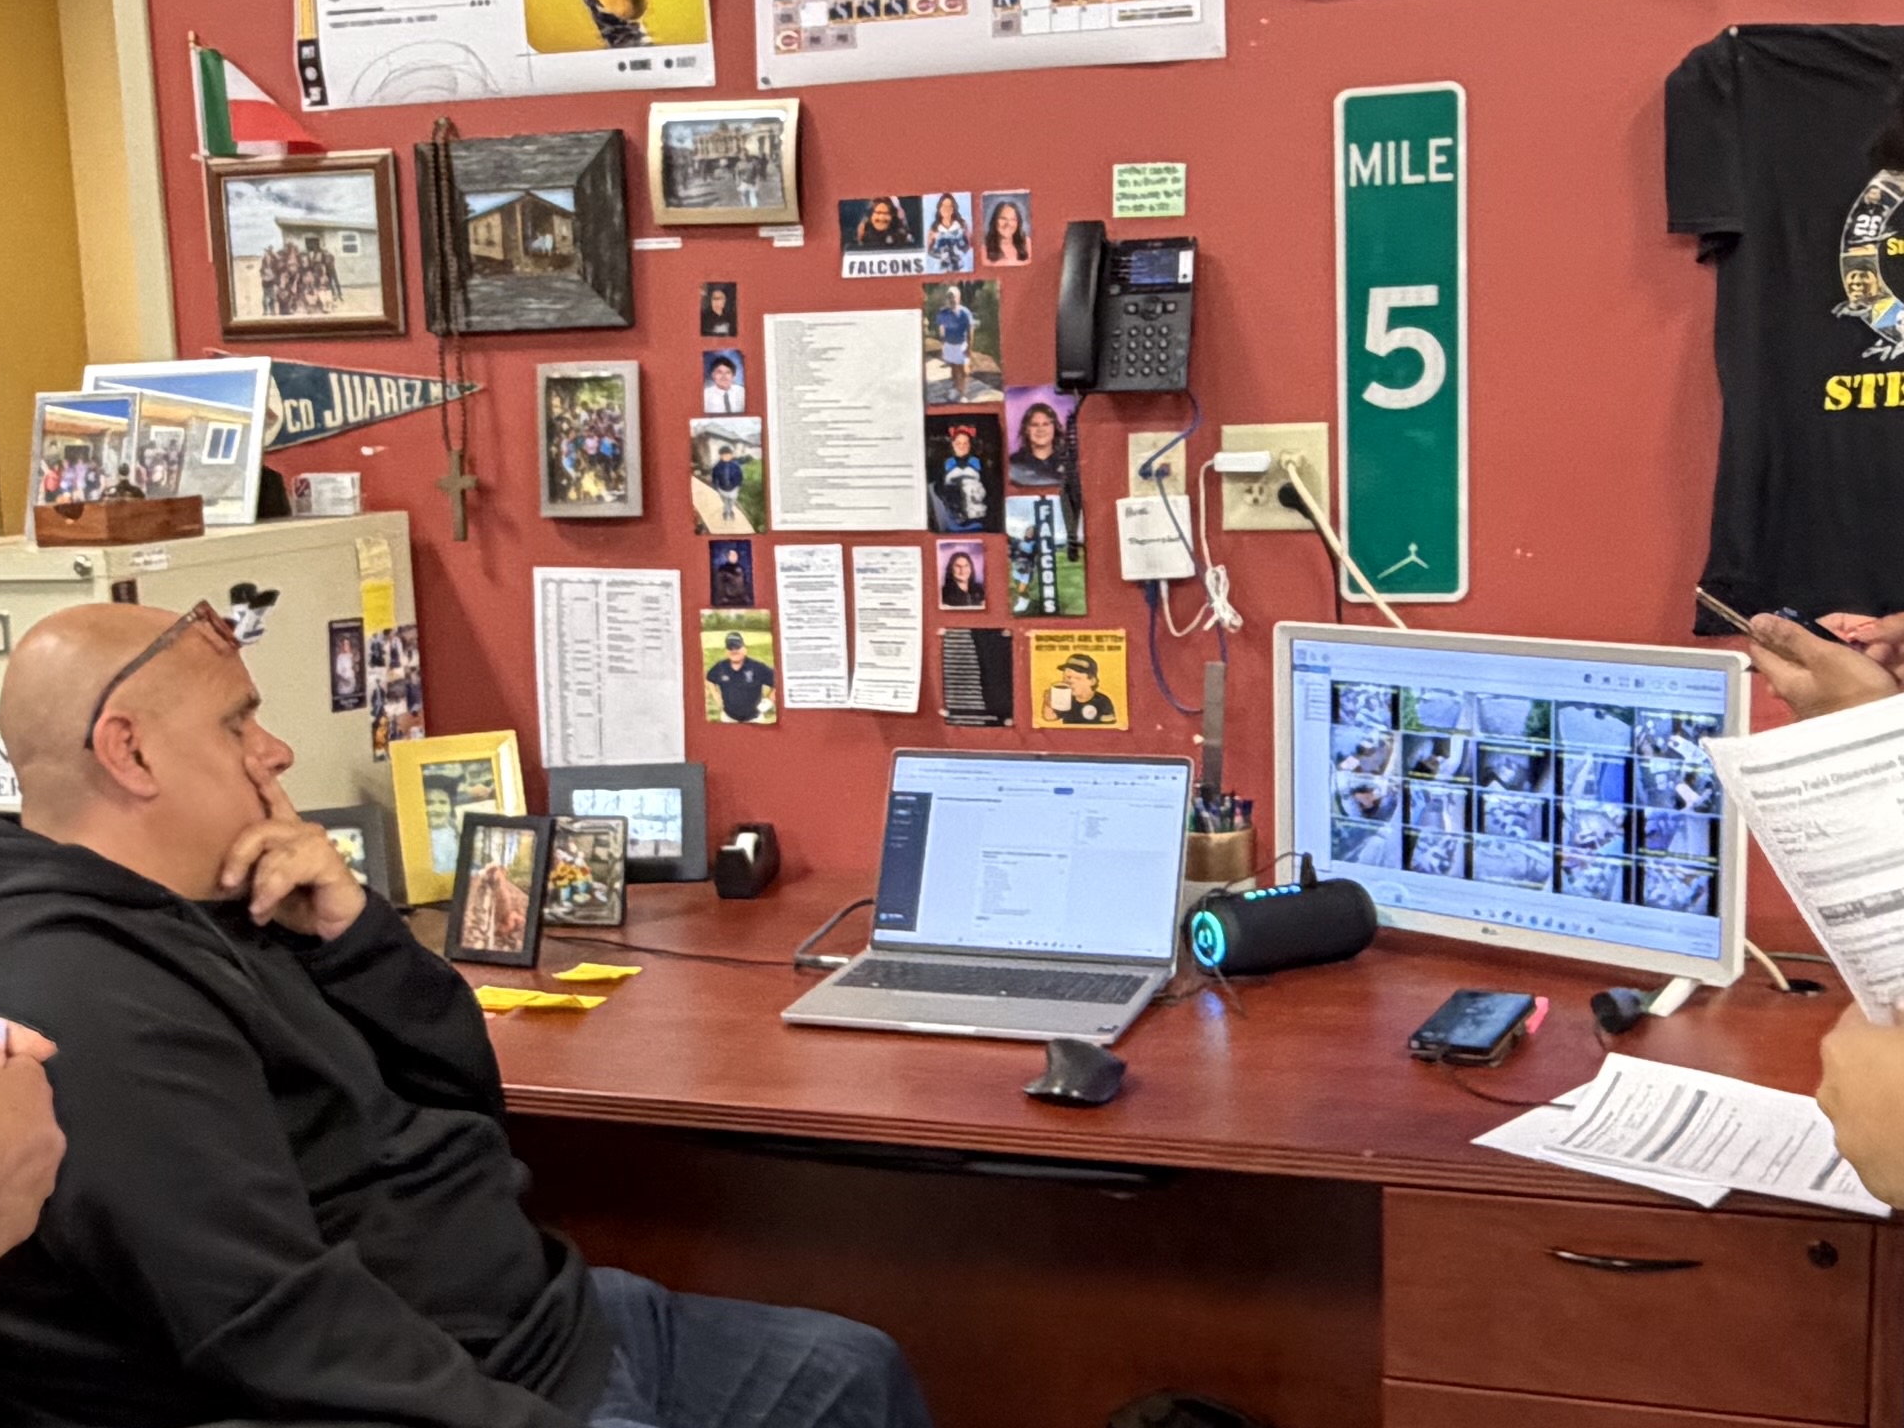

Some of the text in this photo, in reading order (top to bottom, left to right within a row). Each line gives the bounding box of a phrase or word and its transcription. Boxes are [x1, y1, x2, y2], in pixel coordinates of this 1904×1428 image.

[1348, 137, 1454, 187] MILE
[848, 257, 924, 276] FALCONS
[1362, 284, 1448, 410] 5
[323, 372, 424, 429] JUAREZ
[1039, 504, 1056, 613] FALCONS
